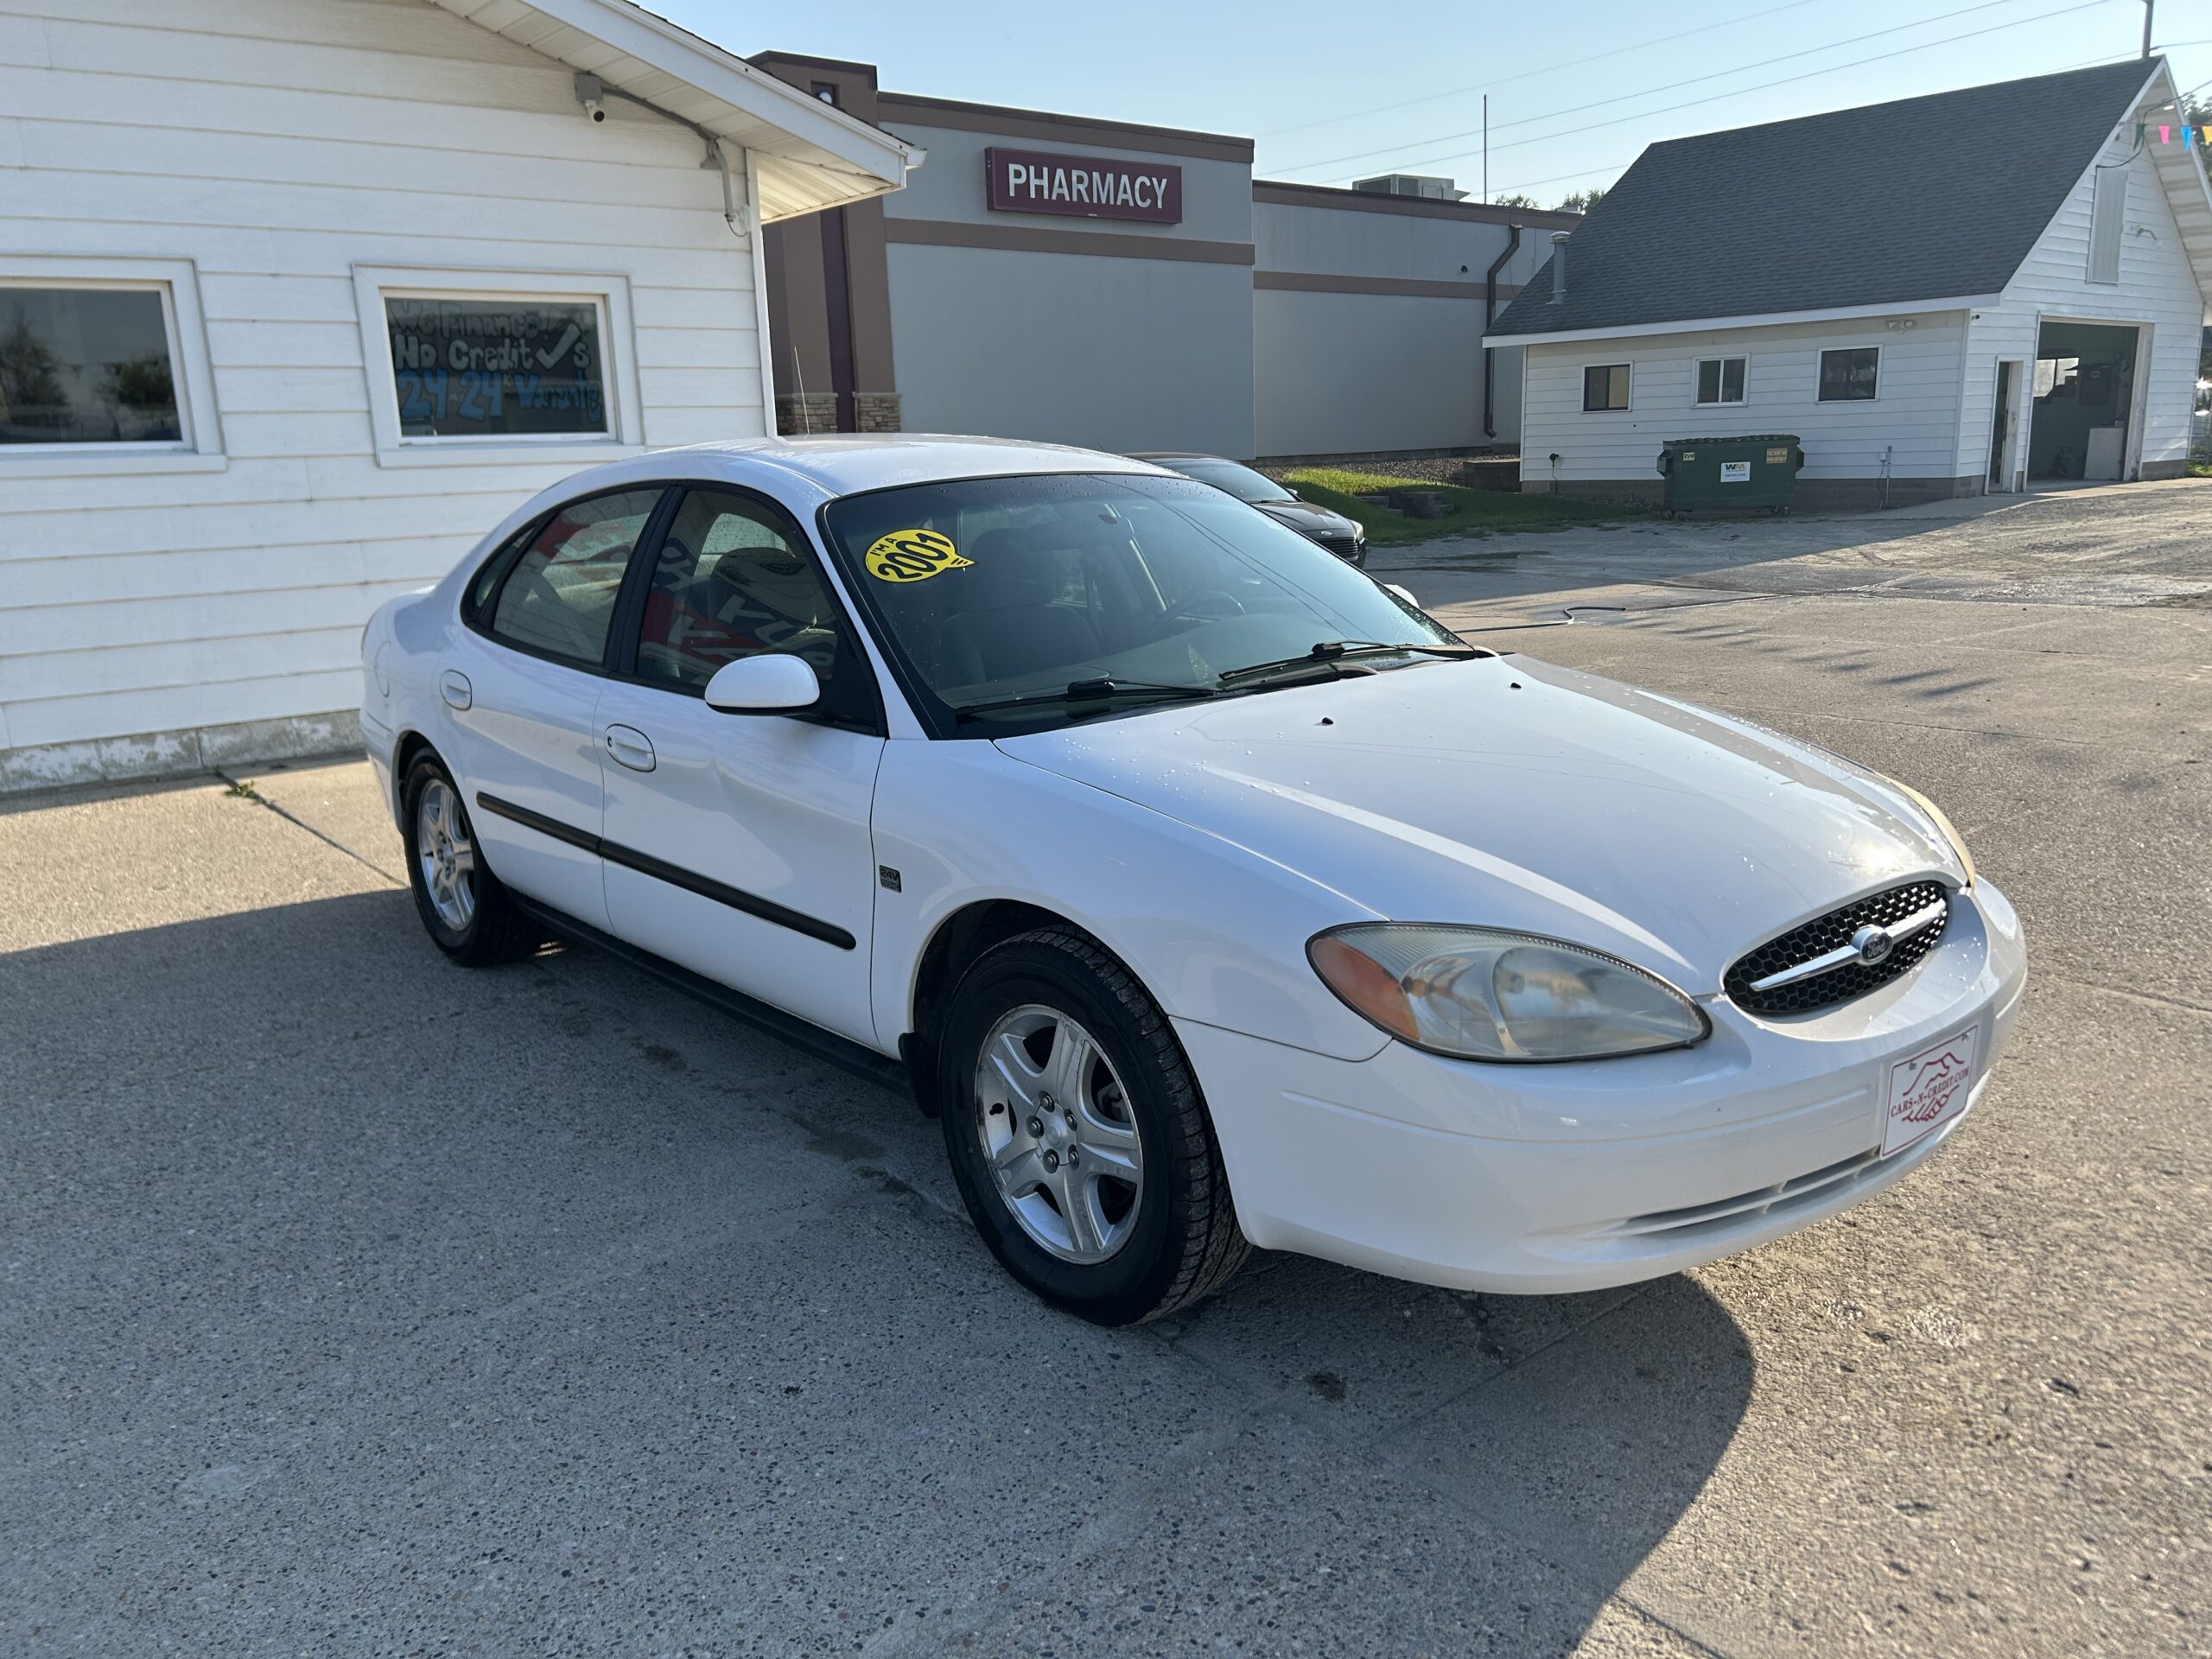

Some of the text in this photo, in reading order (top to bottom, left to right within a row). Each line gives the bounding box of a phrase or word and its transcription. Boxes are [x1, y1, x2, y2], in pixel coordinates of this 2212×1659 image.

[1008, 163, 1167, 209] PHARMACY
[394, 334, 437, 370] No
[448, 337, 535, 372] Credit
[397, 369, 448, 421] 24
[458, 369, 503, 422] 24
[870, 543, 889, 556] I'M
[877, 532, 951, 579] 2001
